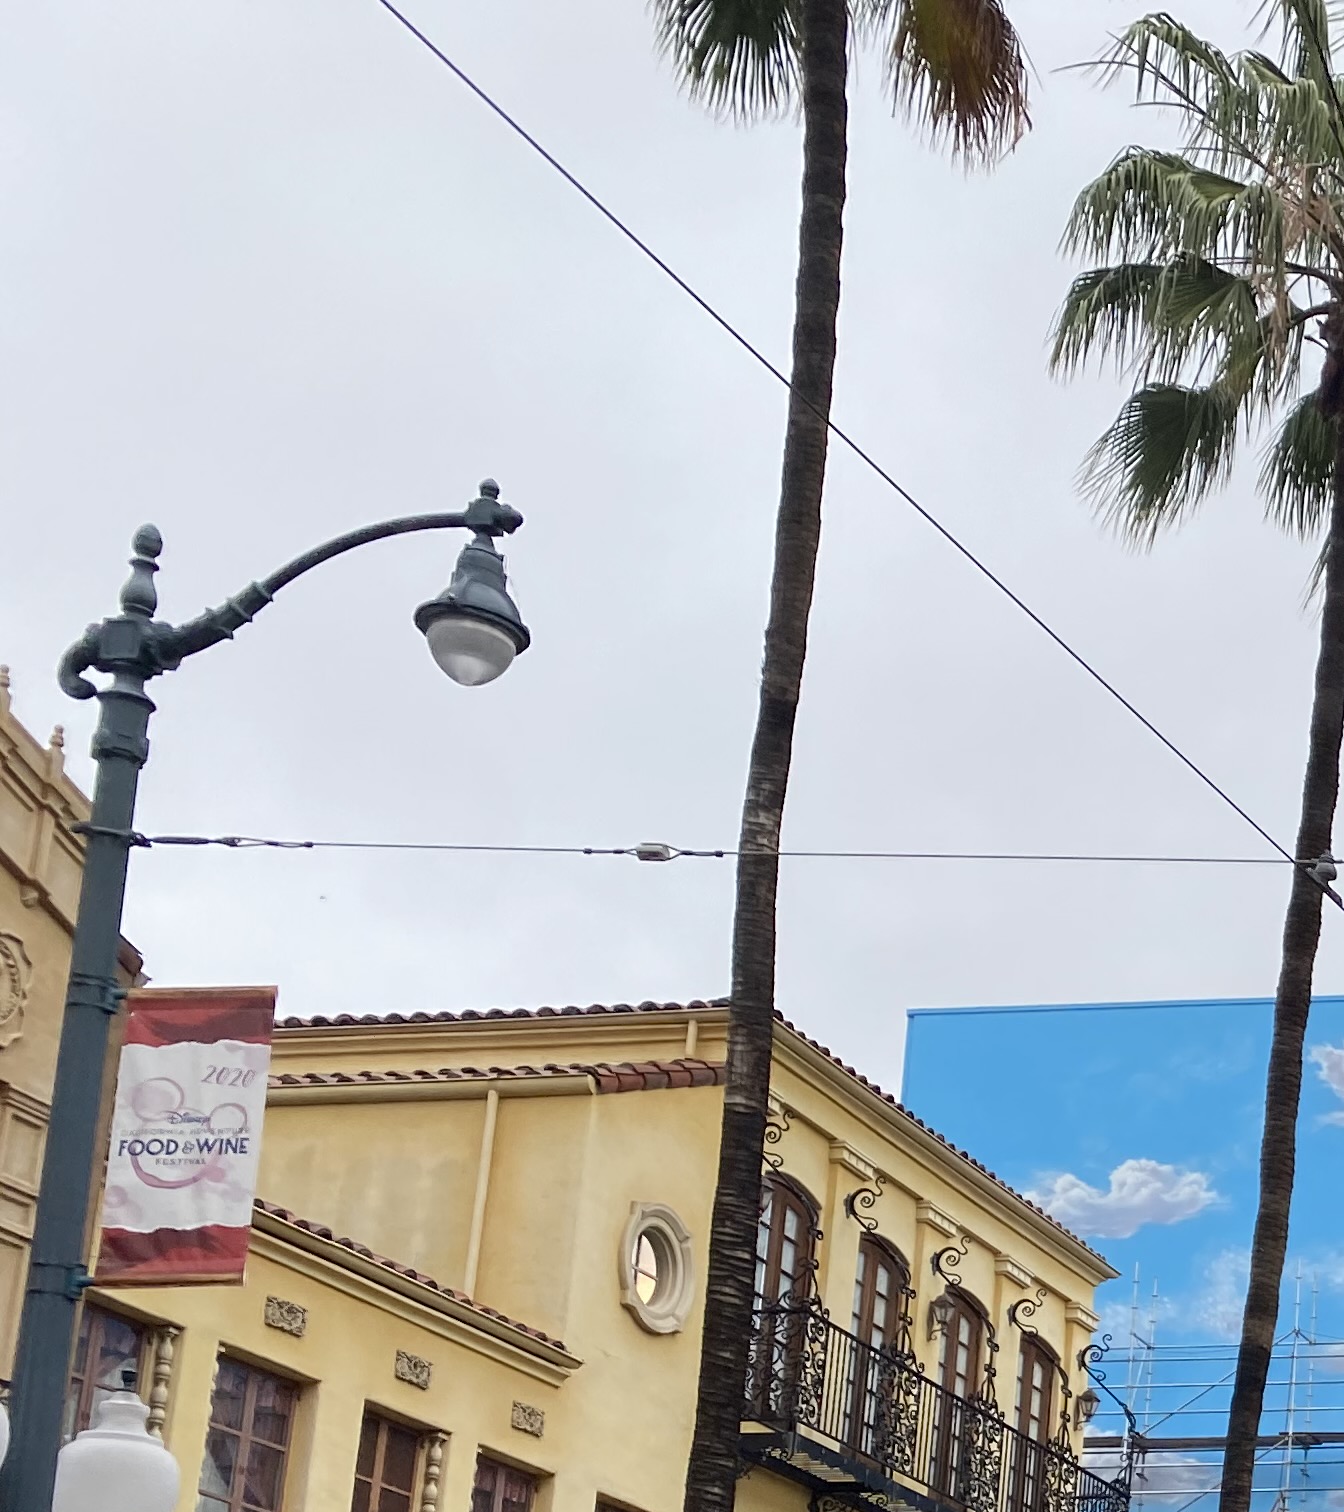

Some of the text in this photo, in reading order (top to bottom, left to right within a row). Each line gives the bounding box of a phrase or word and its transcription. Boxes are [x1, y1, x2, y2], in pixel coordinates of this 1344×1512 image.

[202, 1065, 256, 1088] 2020
[118, 1138, 249, 1156] FOOD & WINE
